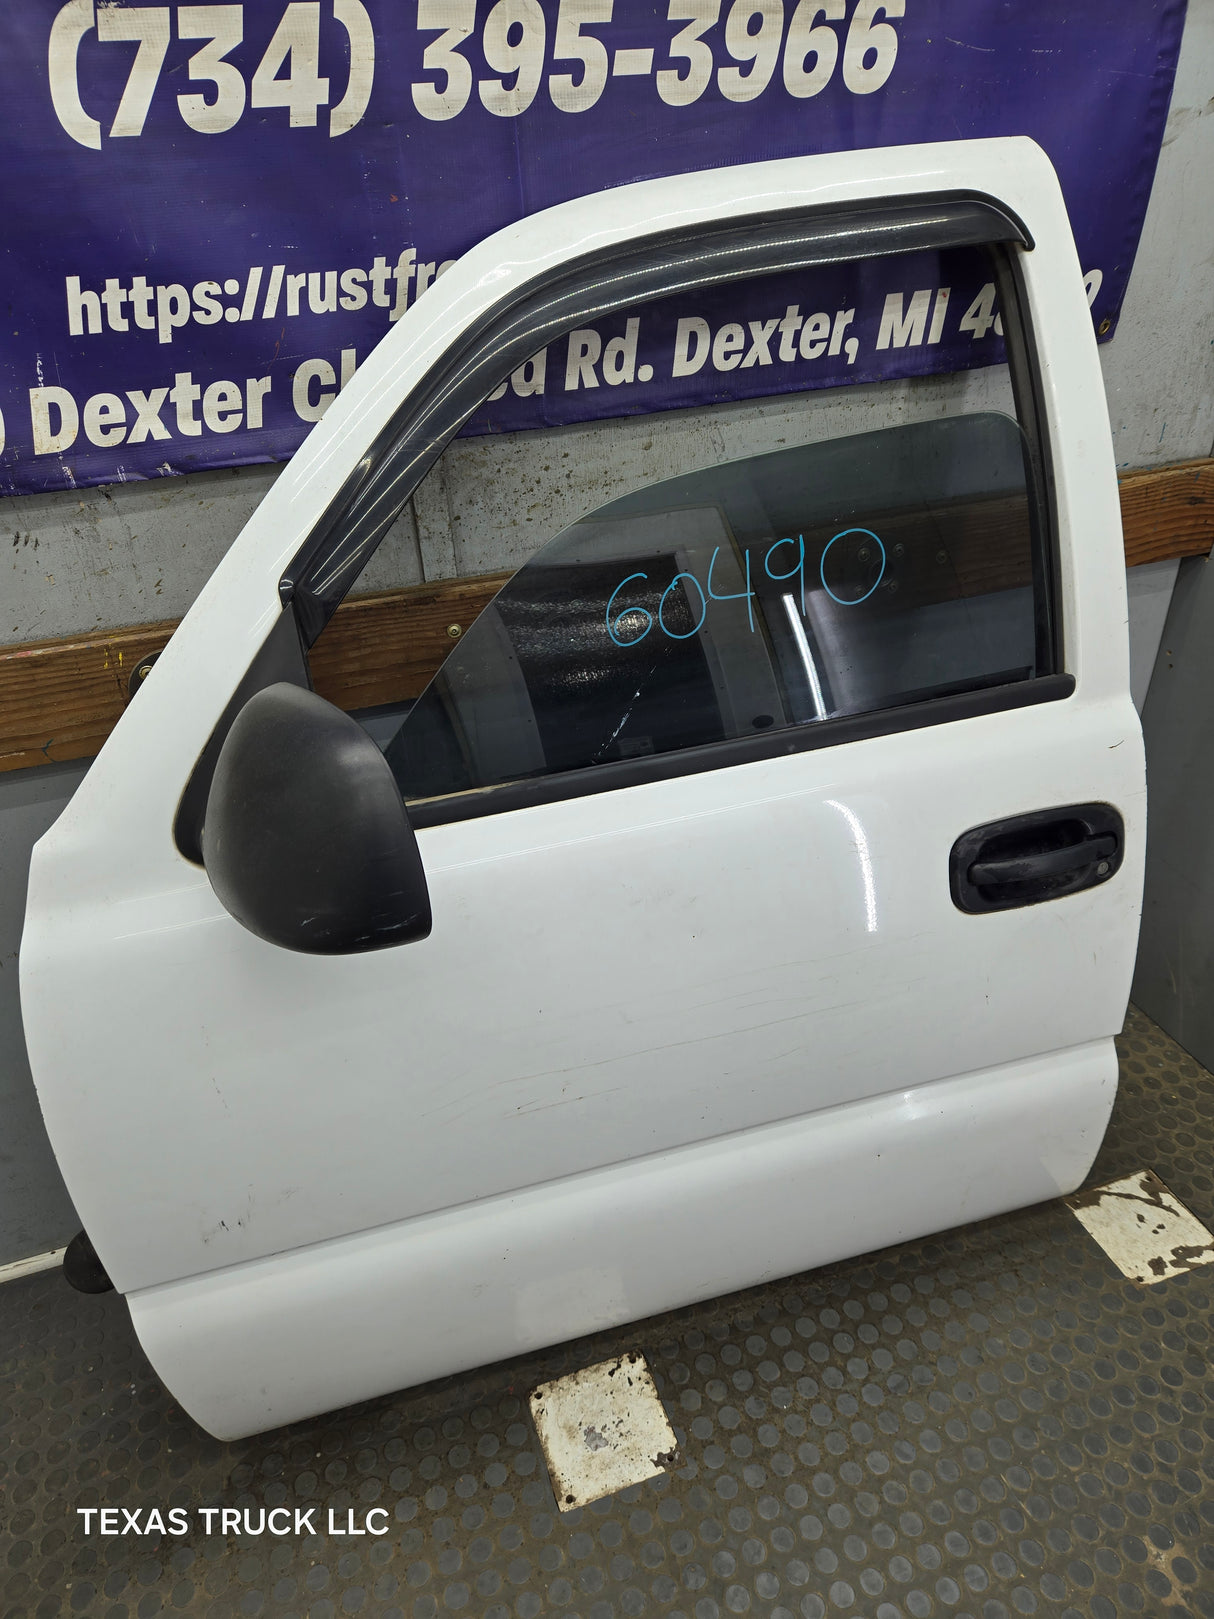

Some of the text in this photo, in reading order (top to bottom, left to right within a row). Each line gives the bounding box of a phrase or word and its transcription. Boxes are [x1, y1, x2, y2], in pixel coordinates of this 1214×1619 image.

[48, 0, 905, 150] (734) 395-3966
[29, 372, 272, 456] Dexter
[564, 317, 655, 393] Rd.
[671, 304, 860, 379] Dexter,
[876, 286, 951, 350] MI
[605, 527, 886, 647] 60490
